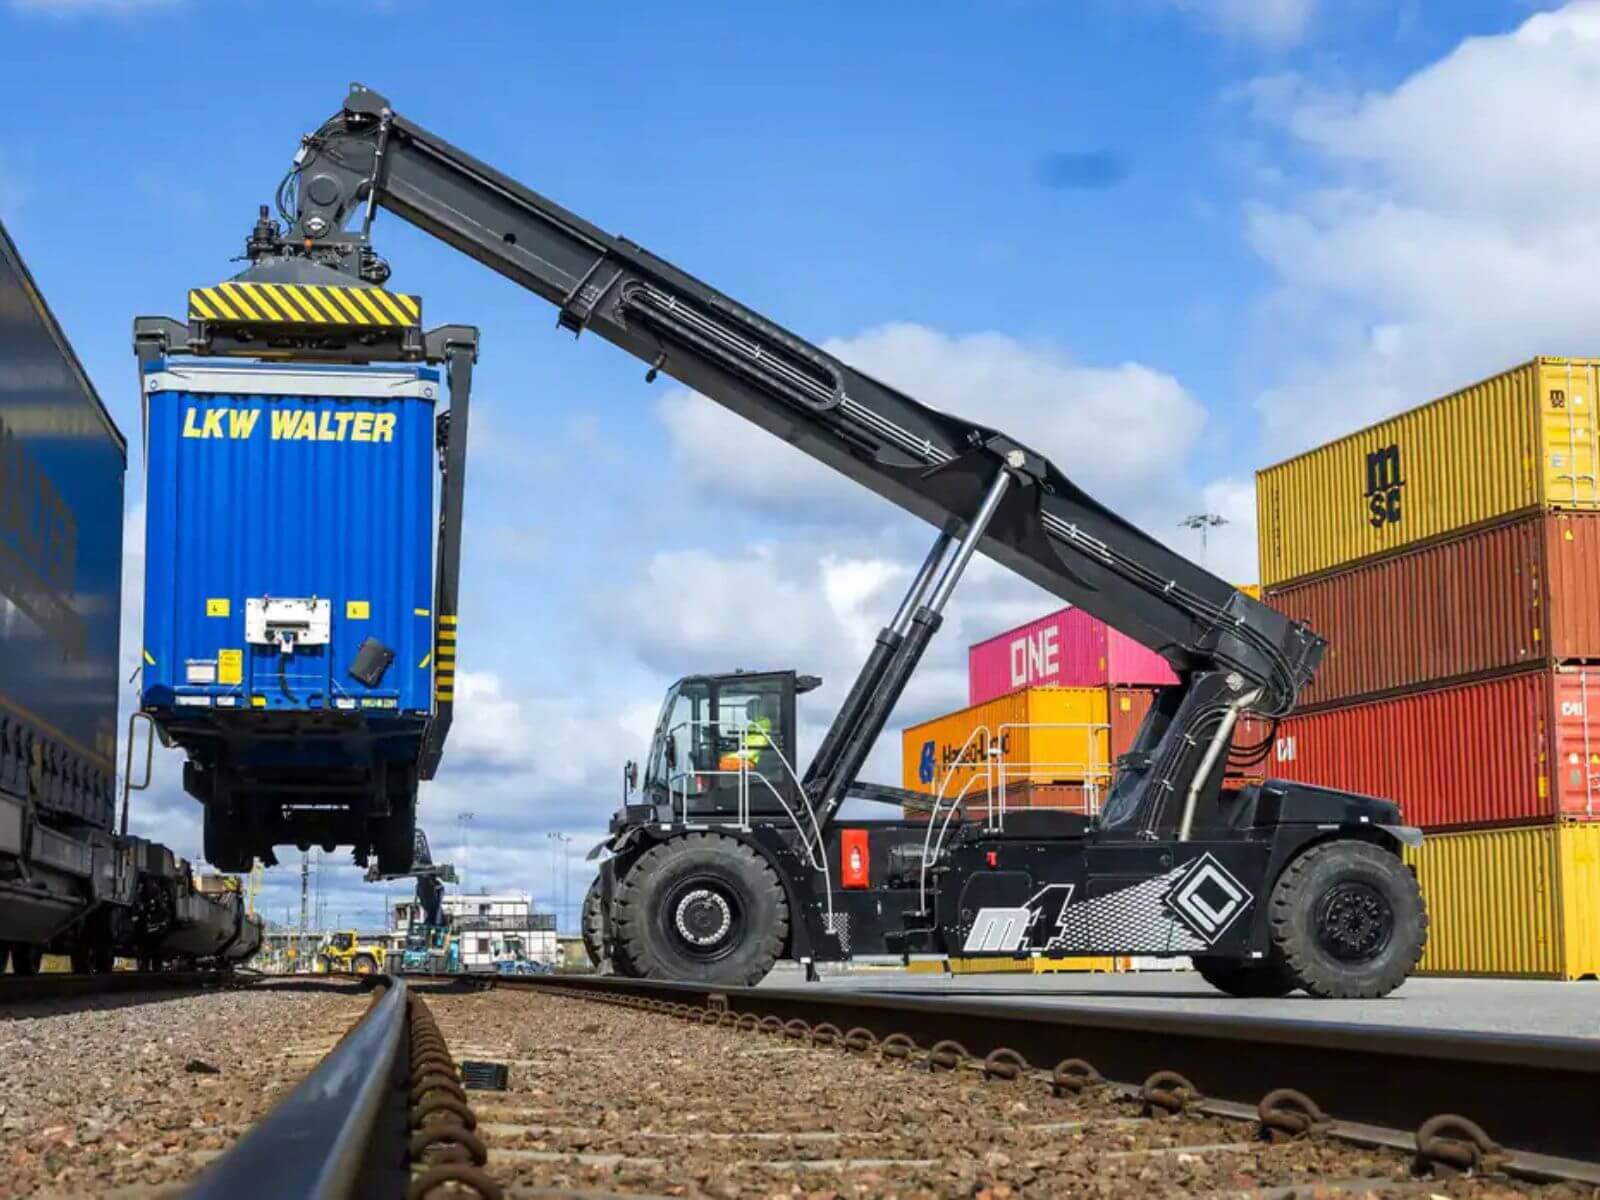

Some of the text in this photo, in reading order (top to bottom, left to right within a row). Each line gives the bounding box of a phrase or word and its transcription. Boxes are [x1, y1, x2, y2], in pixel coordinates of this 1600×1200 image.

[182, 407, 397, 442] LKW WALTER
[1010, 624, 1059, 688] ONE
